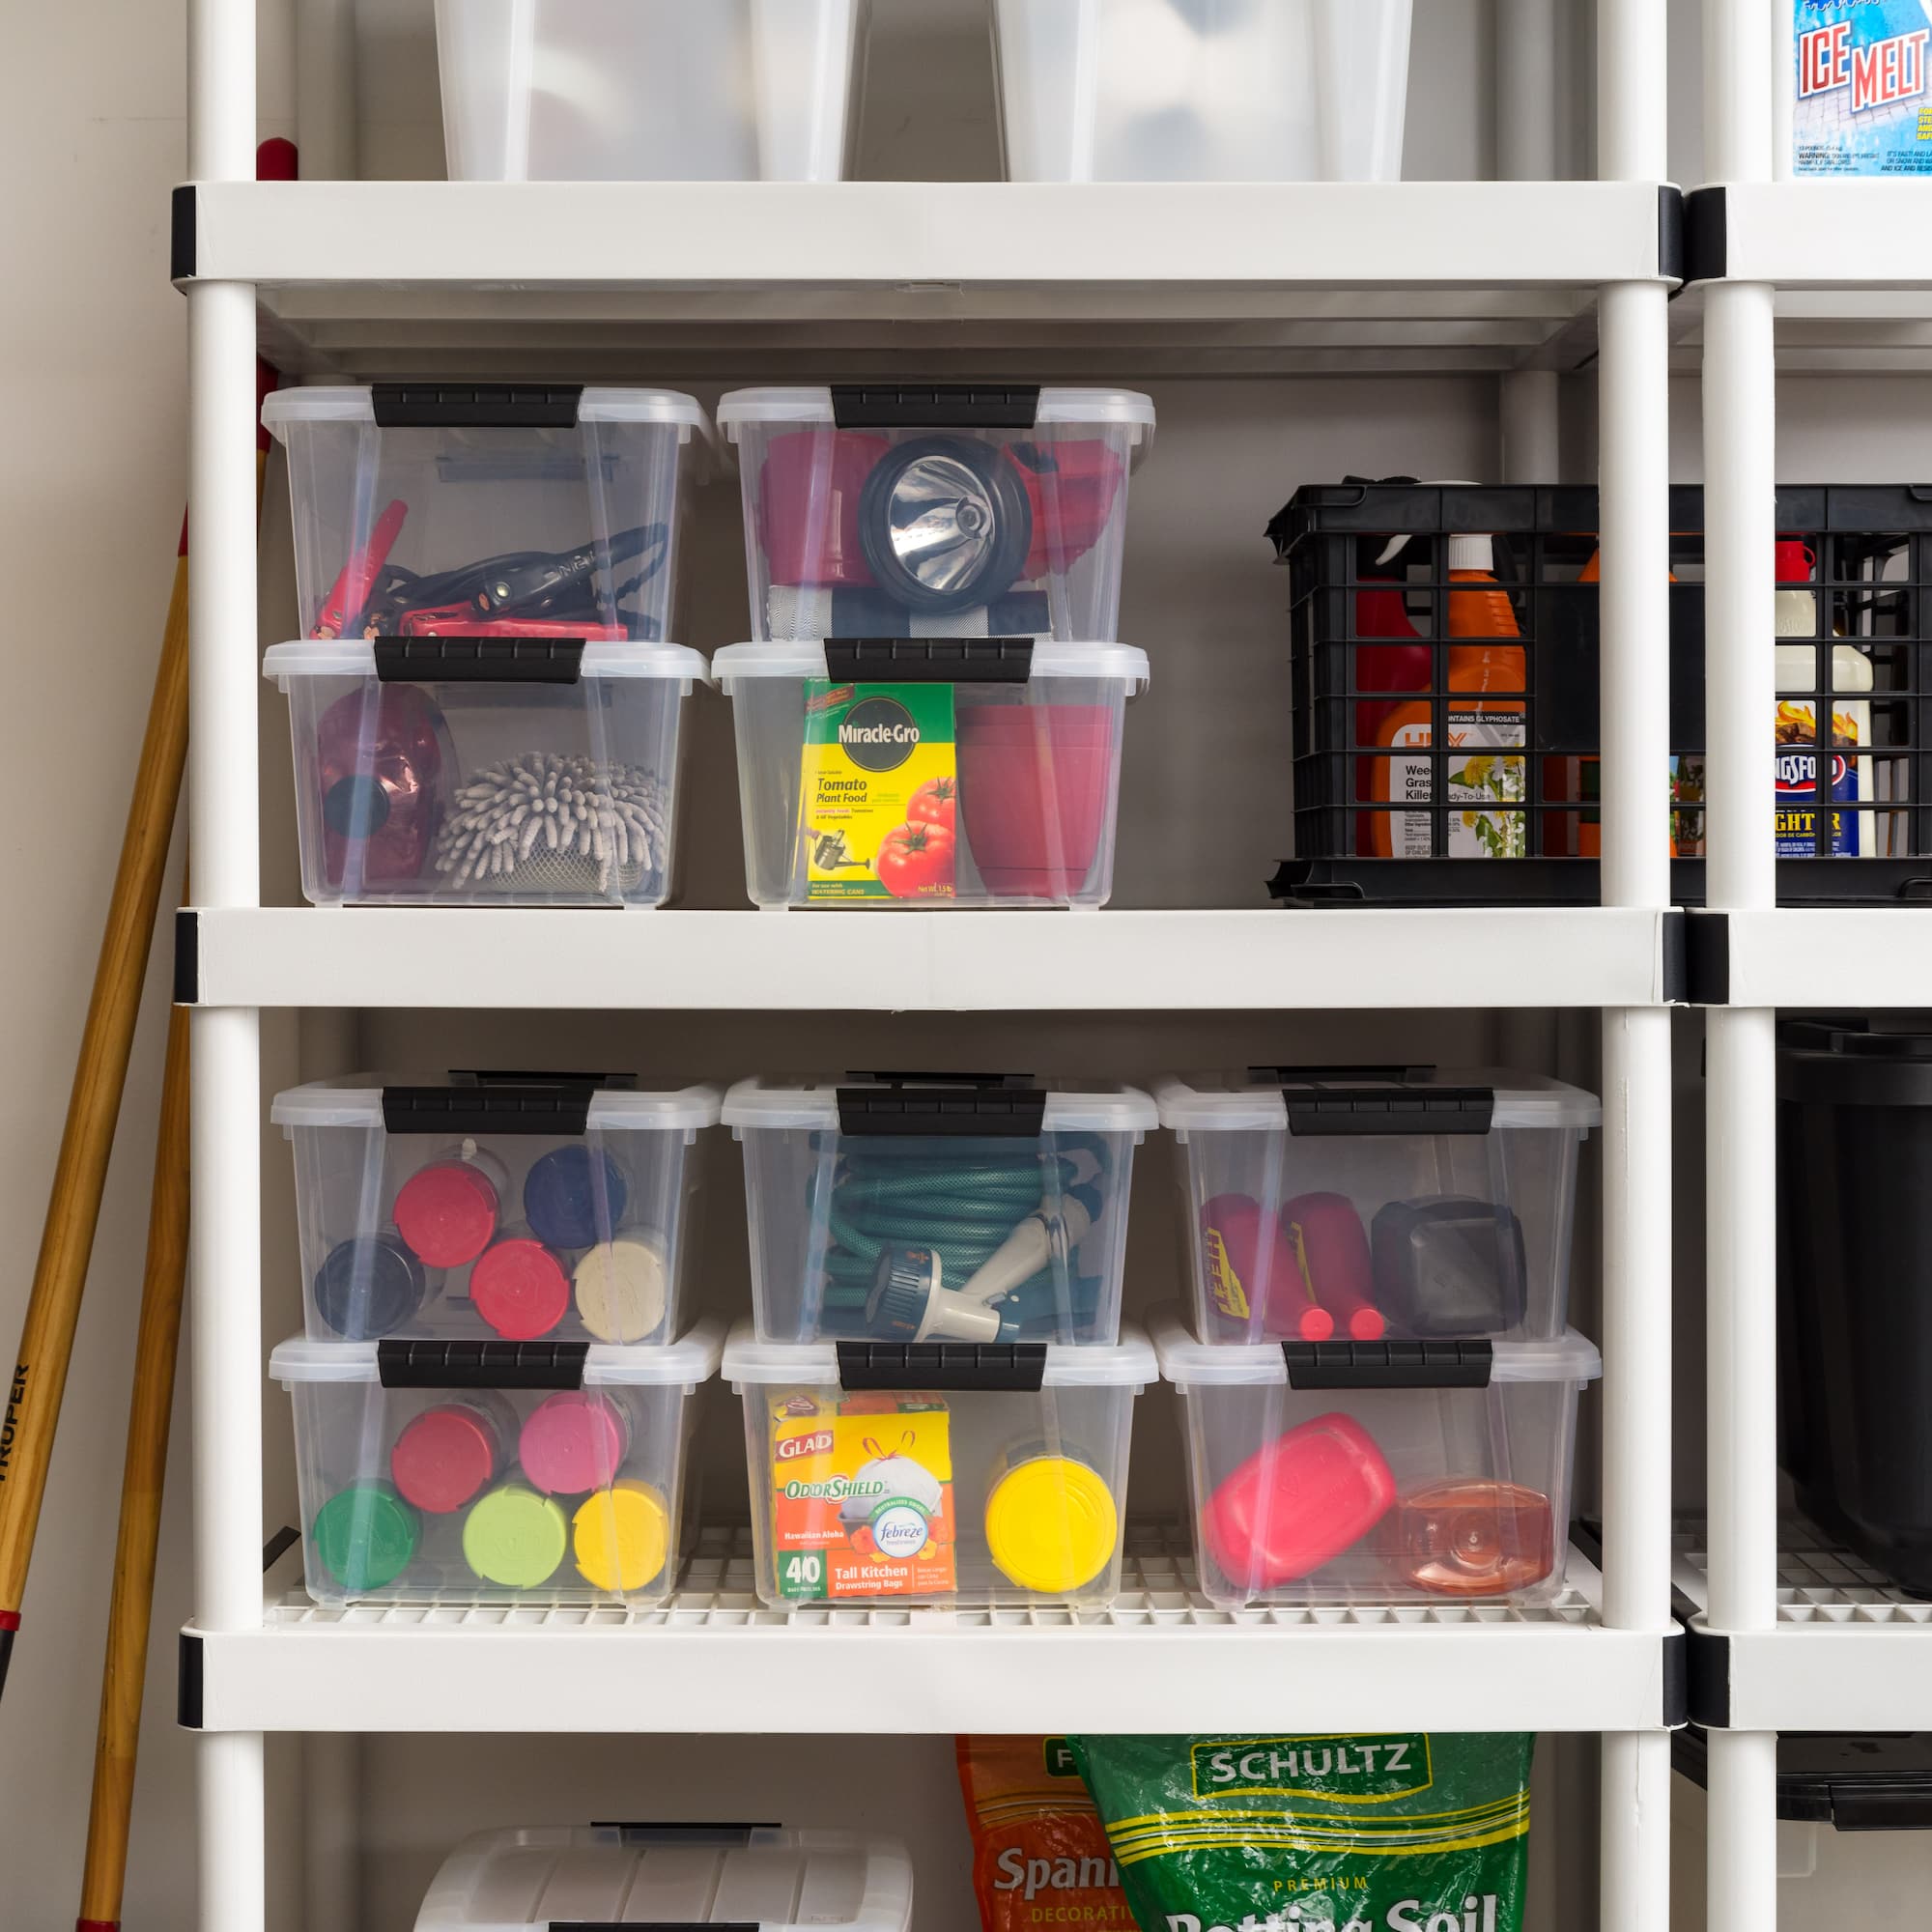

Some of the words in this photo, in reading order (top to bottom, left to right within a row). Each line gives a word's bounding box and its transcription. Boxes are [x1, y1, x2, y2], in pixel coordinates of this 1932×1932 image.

[1802, 24, 1849, 96] ICE
[1854, 31, 1928, 110] MELT
[838, 724, 920, 743] Miracle-Gro
[1406, 765, 1432, 776] Wee
[818, 778, 867, 791] Tomato
[1406, 778, 1432, 787] Gras
[816, 793, 841, 803] Plant
[843, 792, 867, 803] Food
[779, 1435, 833, 1458] GLAD
[784, 1531, 821, 1540] Hawaiian
[822, 1530, 844, 1539] Aloha
[881, 1521, 923, 1542] febreze
[785, 1556, 821, 1583] 40
[835, 1567, 859, 1579] Tall
[862, 1565, 908, 1578] Kitchen
[836, 1580, 882, 1591] Drawstring
[884, 1579, 903, 1590] Bags
[1210, 1742, 1412, 1782] SCHULTZ
[1274, 1876, 1369, 1892] PREMIUM
